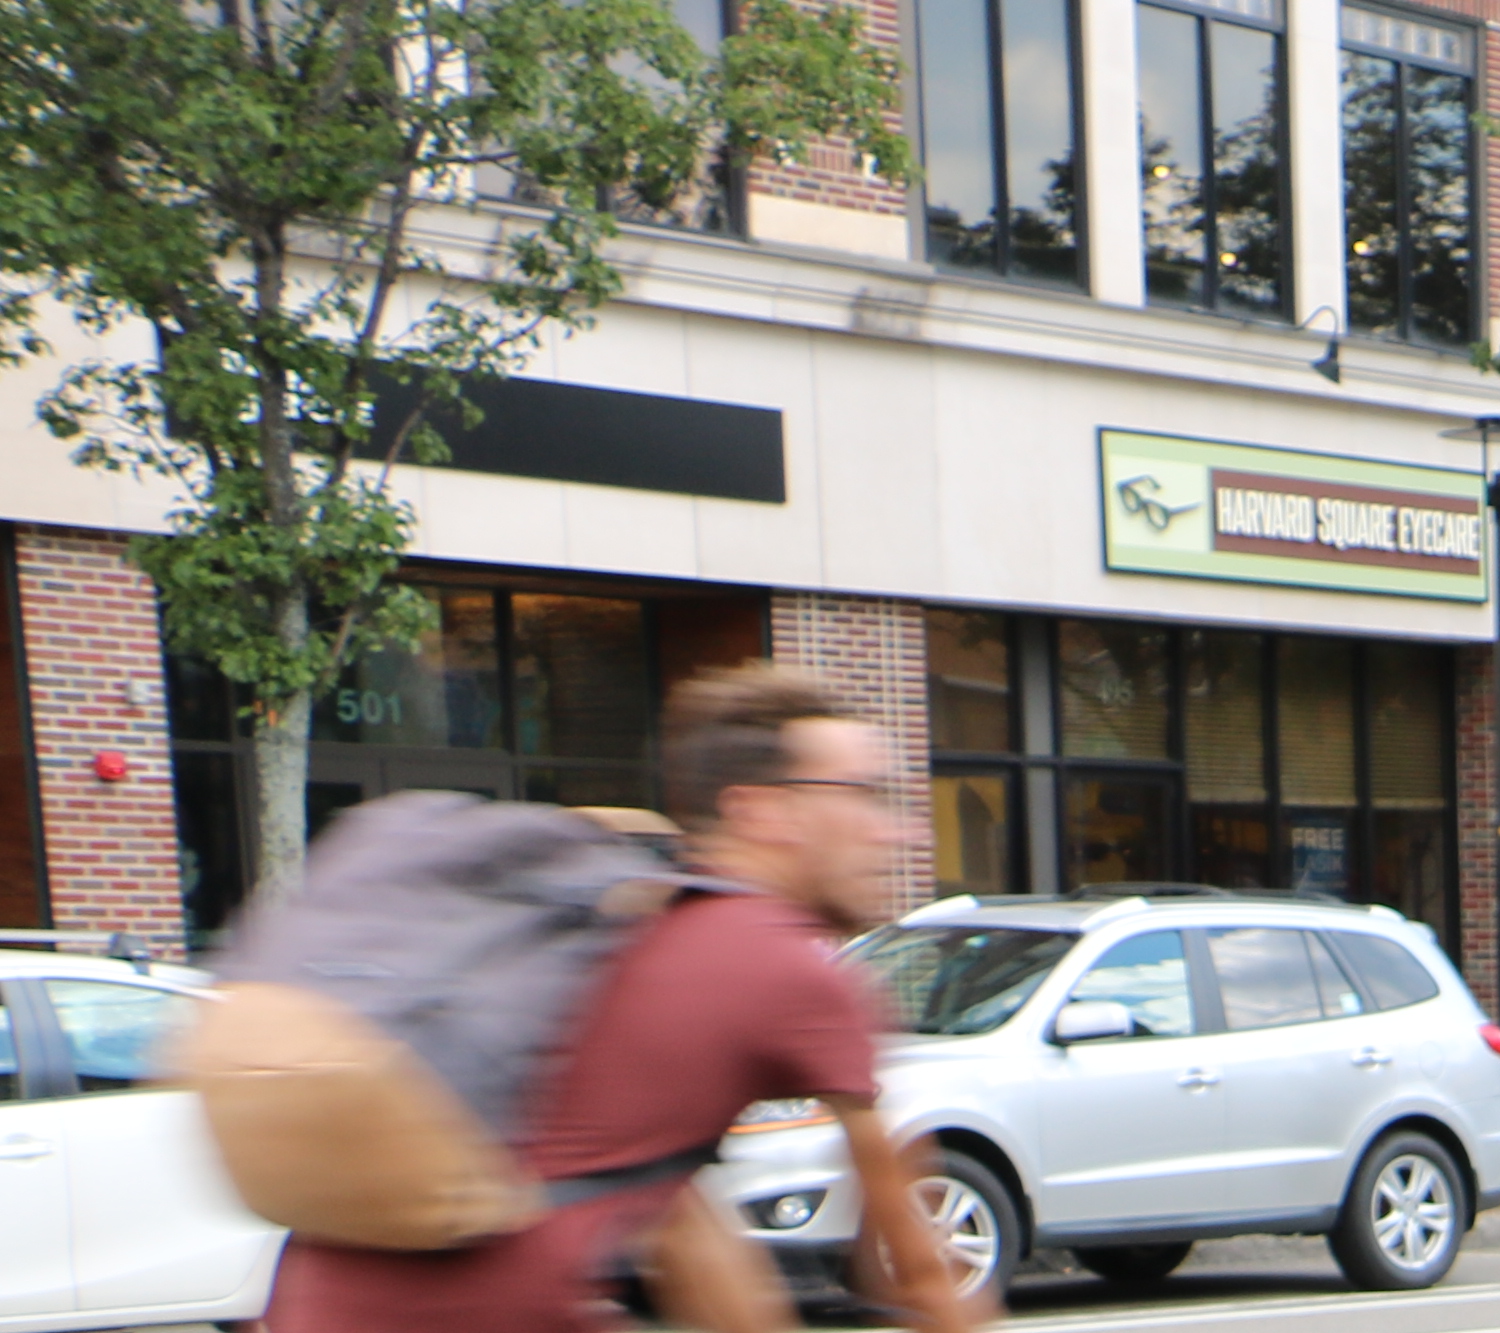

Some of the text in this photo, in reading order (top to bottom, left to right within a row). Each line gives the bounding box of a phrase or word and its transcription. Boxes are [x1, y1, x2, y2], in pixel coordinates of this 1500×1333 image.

[1216, 486, 1482, 560] HARVARD SQUARE EYECARE
[337, 688, 402, 725] 501
